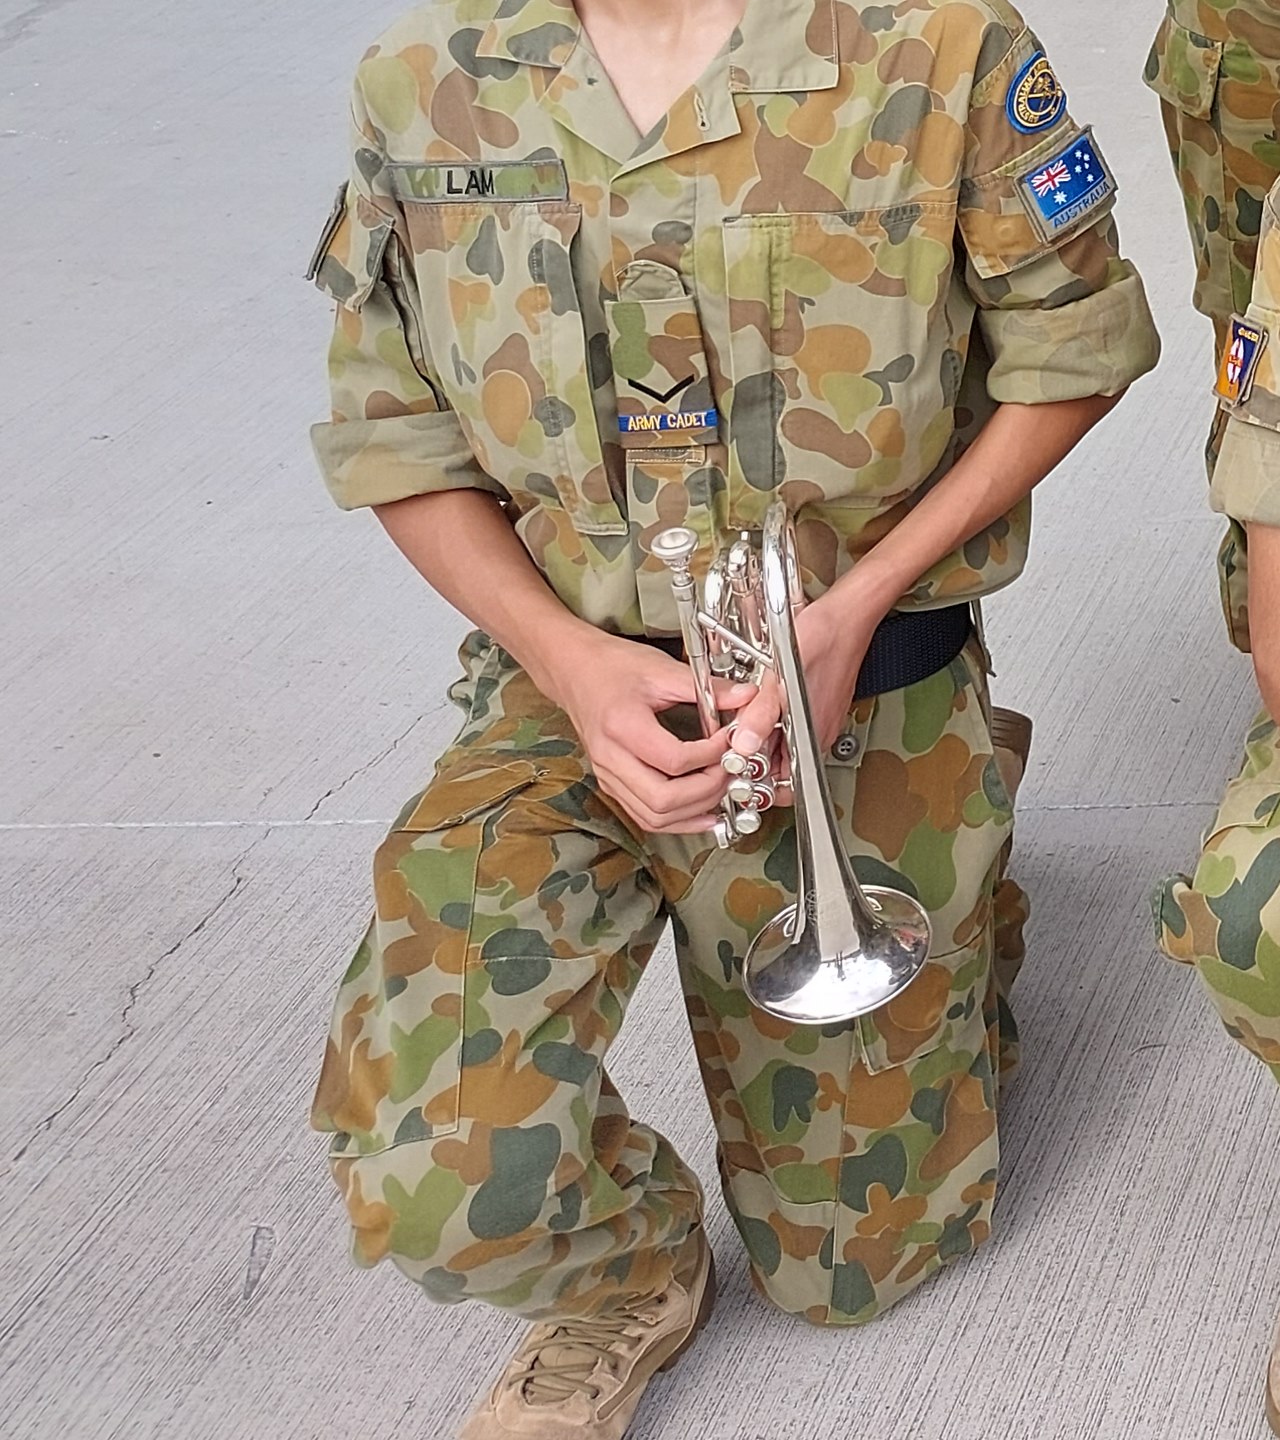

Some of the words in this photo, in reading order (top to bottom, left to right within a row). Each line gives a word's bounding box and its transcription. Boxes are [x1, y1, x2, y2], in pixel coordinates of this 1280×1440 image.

[446, 169, 495, 196] LAM
[1053, 181, 1111, 229] AUSTRALIA
[628, 415, 661, 431] ARMY
[667, 412, 707, 428] CADET
